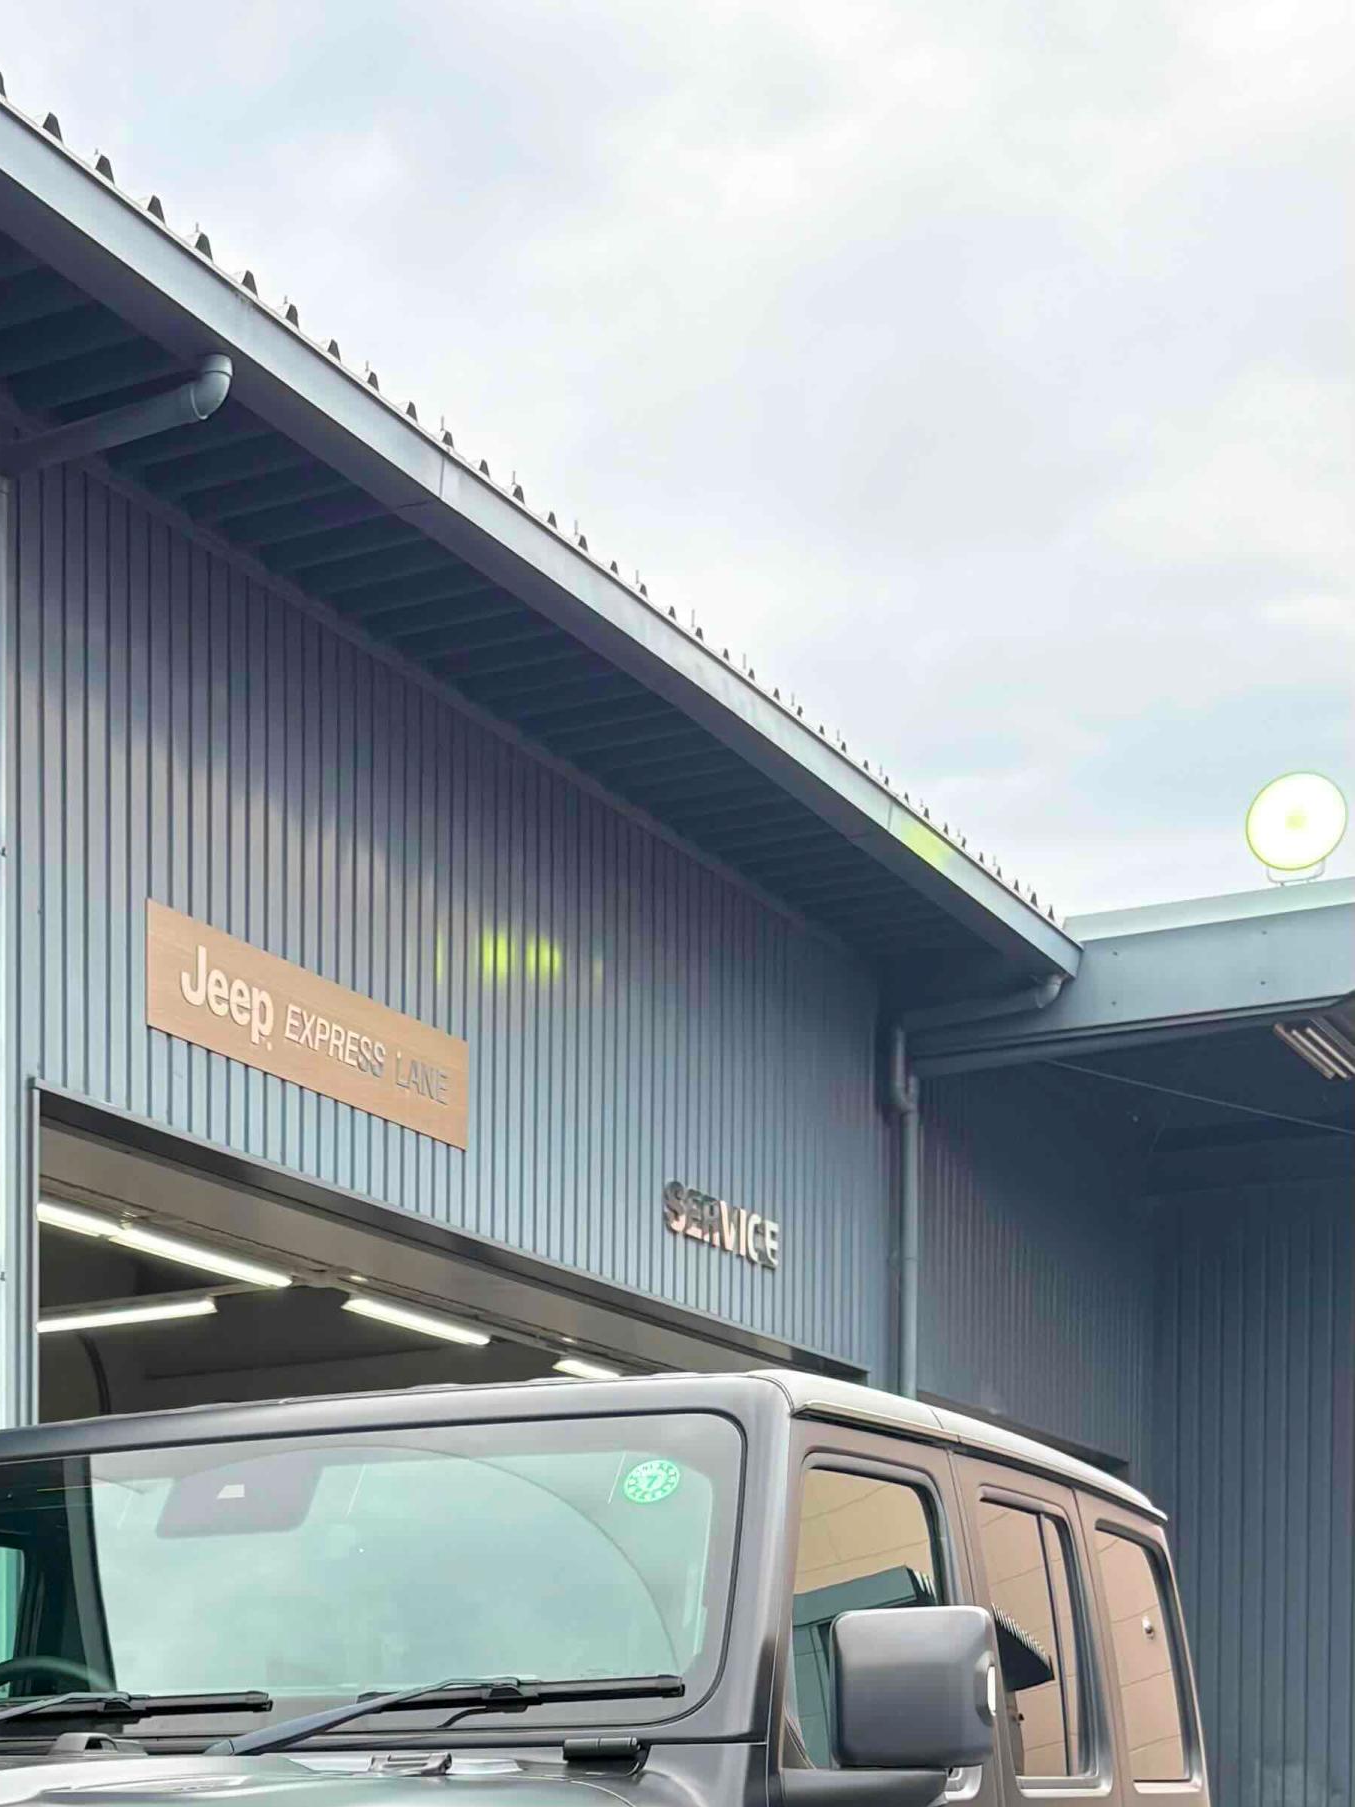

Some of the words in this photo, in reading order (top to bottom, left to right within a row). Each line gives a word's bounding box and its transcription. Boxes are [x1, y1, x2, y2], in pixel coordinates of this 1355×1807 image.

[180, 945, 274, 1048] Jeep
[284, 1003, 387, 1078] EXPRESS
[396, 1051, 450, 1106] LANE
[663, 1179, 780, 1270] SERVICE
